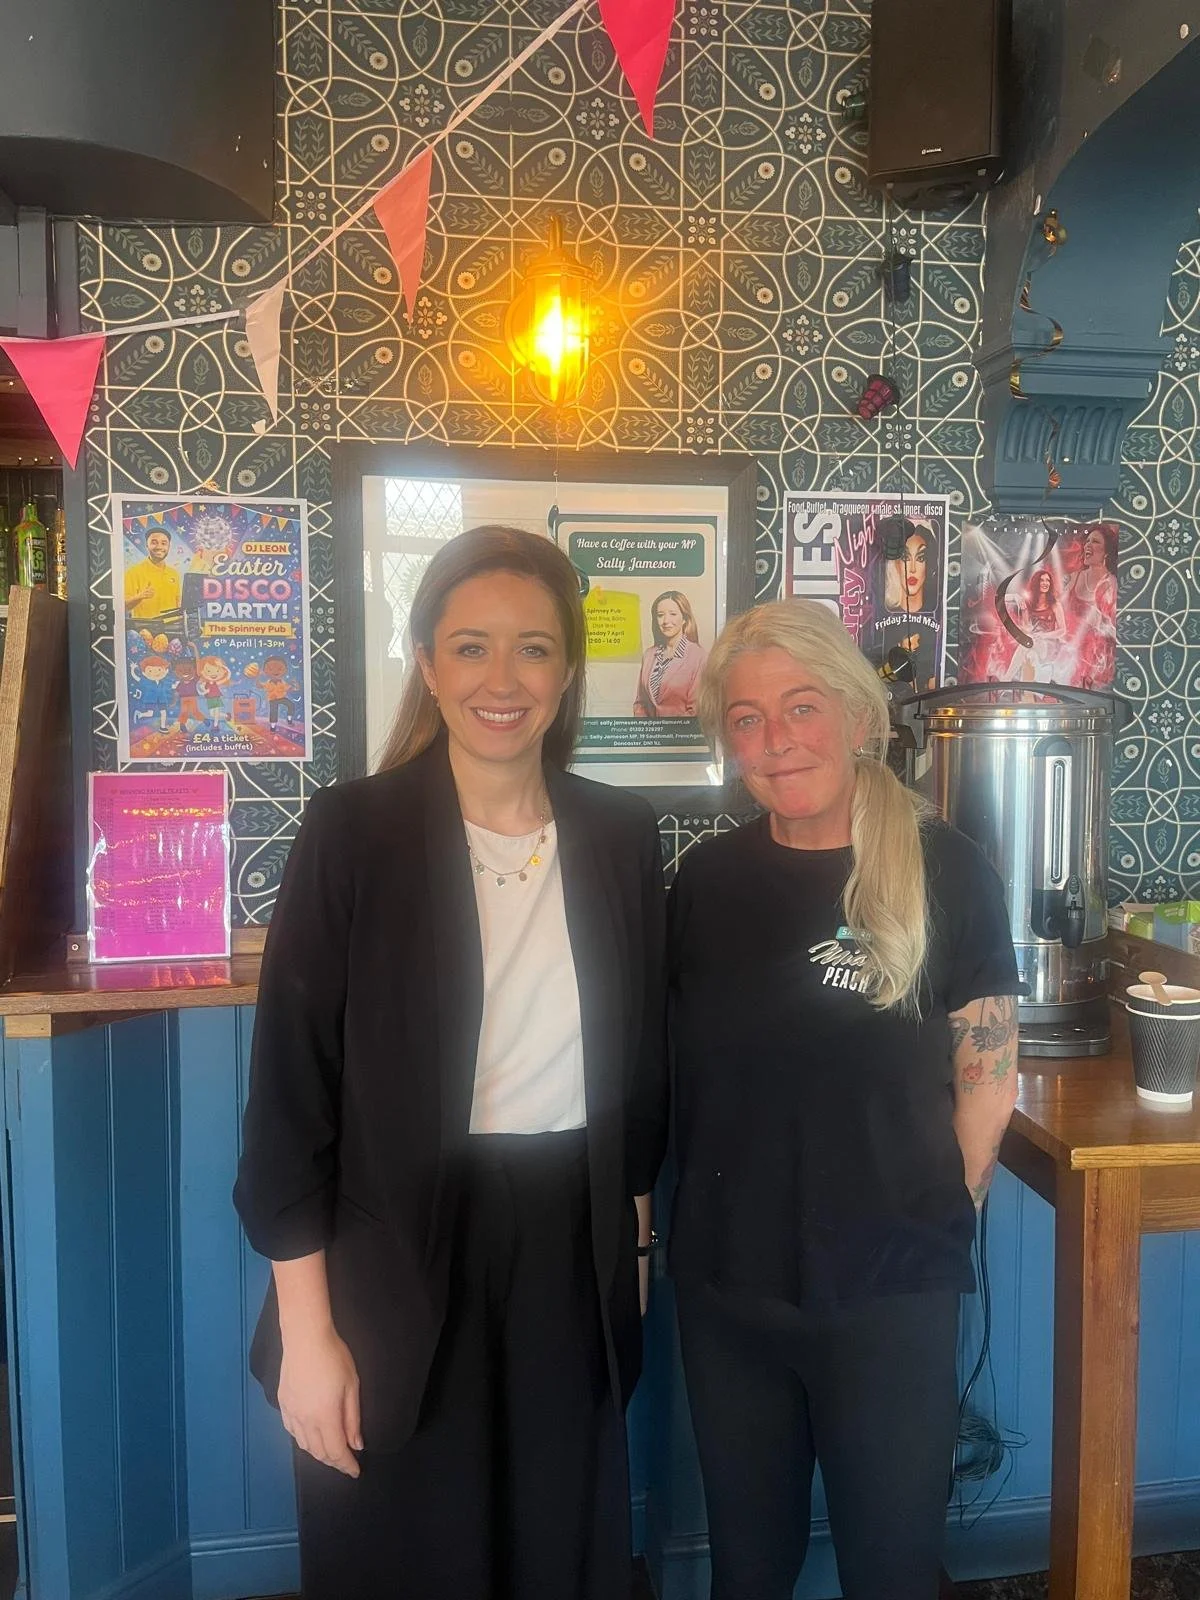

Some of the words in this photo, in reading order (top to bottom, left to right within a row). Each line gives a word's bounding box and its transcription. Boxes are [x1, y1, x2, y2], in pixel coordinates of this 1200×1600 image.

[787, 501, 805, 513] Food
[832, 502, 869, 516] Dragqueen
[875, 503, 892, 515] male
[924, 503, 943, 516] disco
[245, 544, 258, 553] DJ
[260, 544, 287, 553] LEON
[576, 538, 600, 549] Have
[601, 541, 608, 549] a
[610, 538, 635, 551] Coffee
[636, 539, 656, 549] with
[658, 541, 679, 552] your
[681, 539, 697, 550] MP
[211, 553, 287, 576] Easter
[596, 556, 625, 571] Sally
[628, 557, 677, 572] Jameson
[203, 578, 292, 601] DISCO
[207, 602, 288, 619] PARTY!
[209, 624, 226, 633] The
[228, 625, 266, 634] Spinney
[268, 625, 287, 633] Pub
[875, 614, 901, 631] Friday
[923, 615, 941, 632] May
[214, 639, 227, 647] 6th
[229, 639, 252, 648] April
[193, 733, 211, 744] £4
[221, 734, 250, 743] ticket
[186, 744, 223, 752] (includes
[224, 743, 253, 751] buffet)
